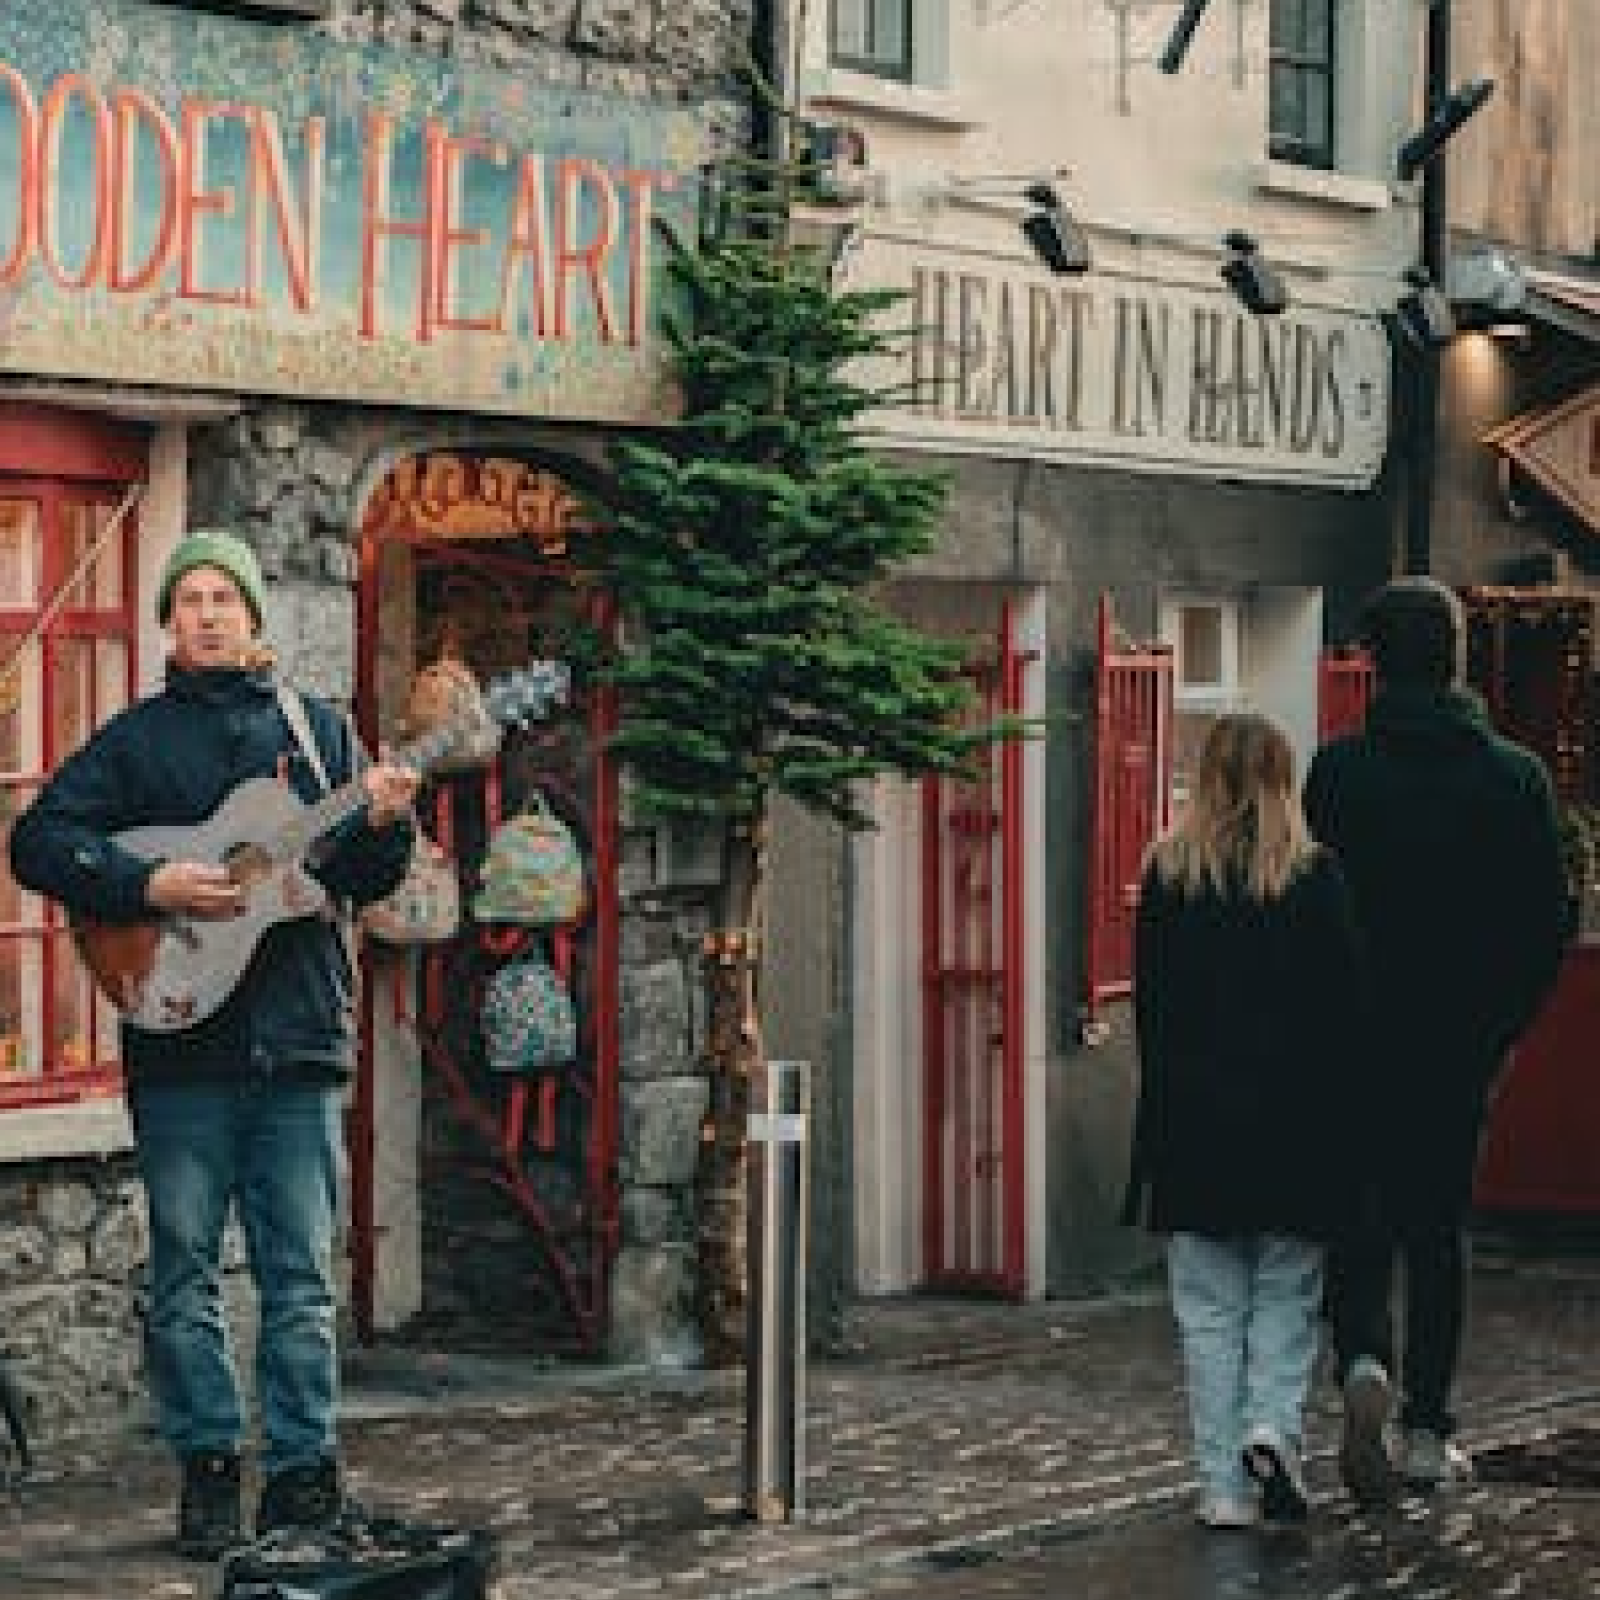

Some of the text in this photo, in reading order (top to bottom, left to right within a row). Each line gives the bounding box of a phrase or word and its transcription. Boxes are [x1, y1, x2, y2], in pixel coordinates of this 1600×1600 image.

[357, 112, 664, 348] HEART
[908, 265, 1346, 459] HEART IN HANDS
